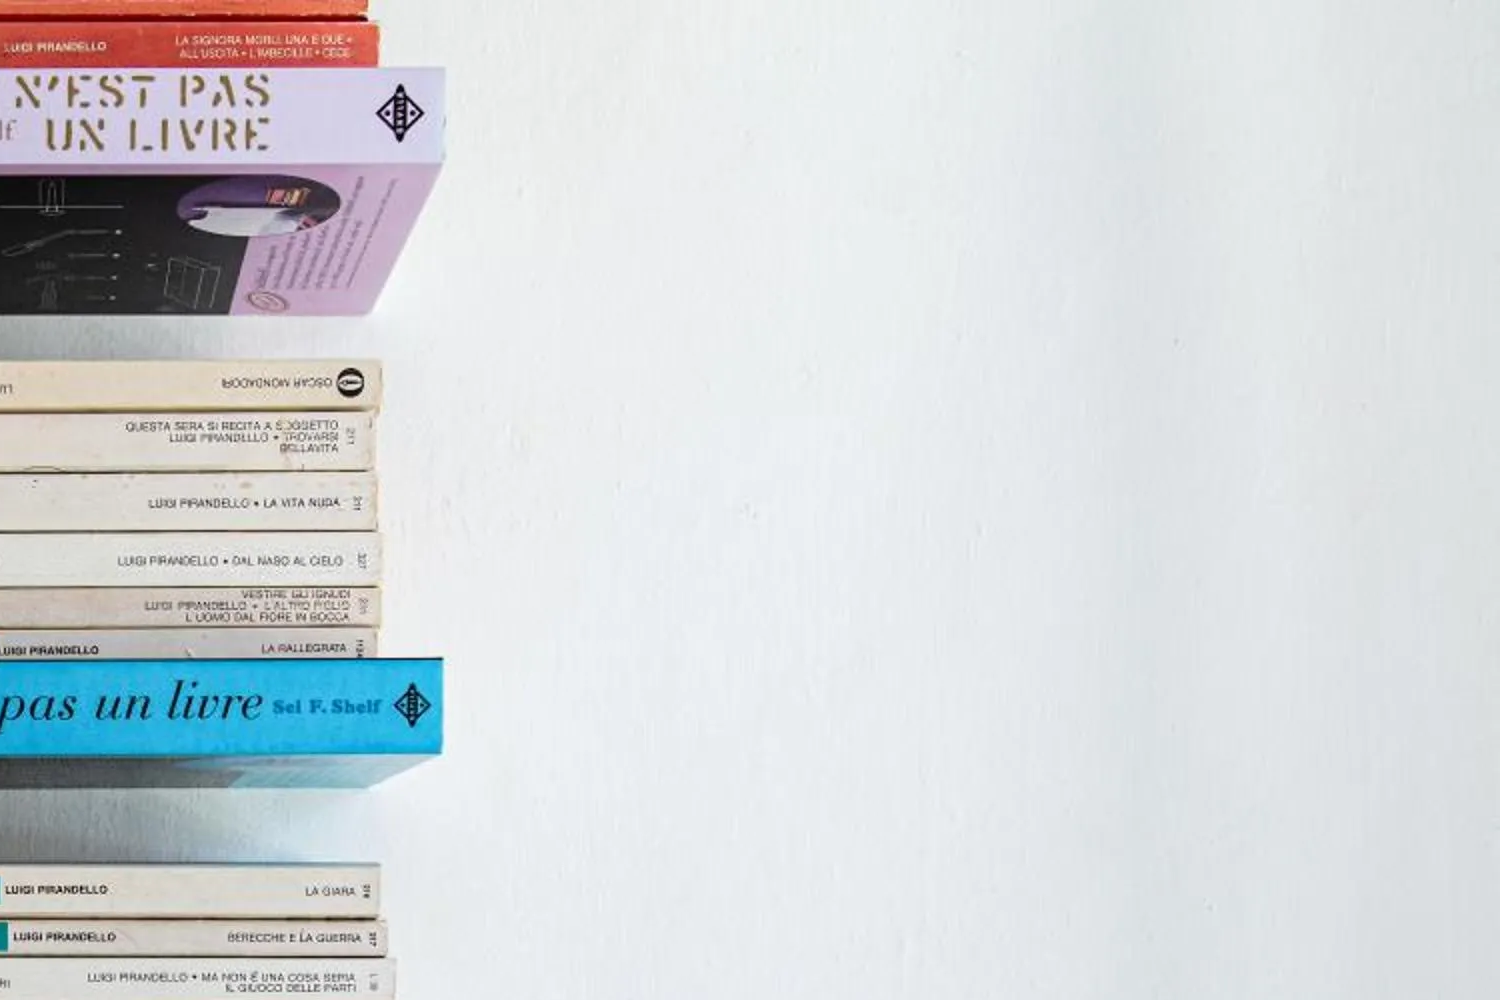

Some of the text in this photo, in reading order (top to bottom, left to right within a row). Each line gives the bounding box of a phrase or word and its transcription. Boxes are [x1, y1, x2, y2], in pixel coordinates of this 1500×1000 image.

[15, 75, 156, 109] N'EST
[180, 75, 270, 109] PAS
[46, 118, 270, 151] UN LIVRE
[221, 377, 333, 388] OSCAR MONDADORI
[169, 433, 269, 443] LUIGI PIRANDELLO
[148, 499, 177, 509] LUIGI
[180, 499, 249, 509] PIRANDELLO
[263, 499, 280, 509] LA
[117, 556, 146, 566] LUIGI
[150, 556, 218, 566] PIRANDELLO
[29, 645, 99, 656] PIRANDELLO
[262, 643, 276, 654] LA
[95, 693, 151, 720] un
[167, 679, 263, 720] livre
[272, 699, 383, 715] Sel F. Shelf
[5, 885, 109, 895] LUIGI PIRANDELLO
[305, 887, 319, 897] LA
[13, 932, 116, 942] LUIGI PIRANDELLO
[87, 972, 117, 983] LUIGI
[120, 972, 188, 983] PIRANDELLO
